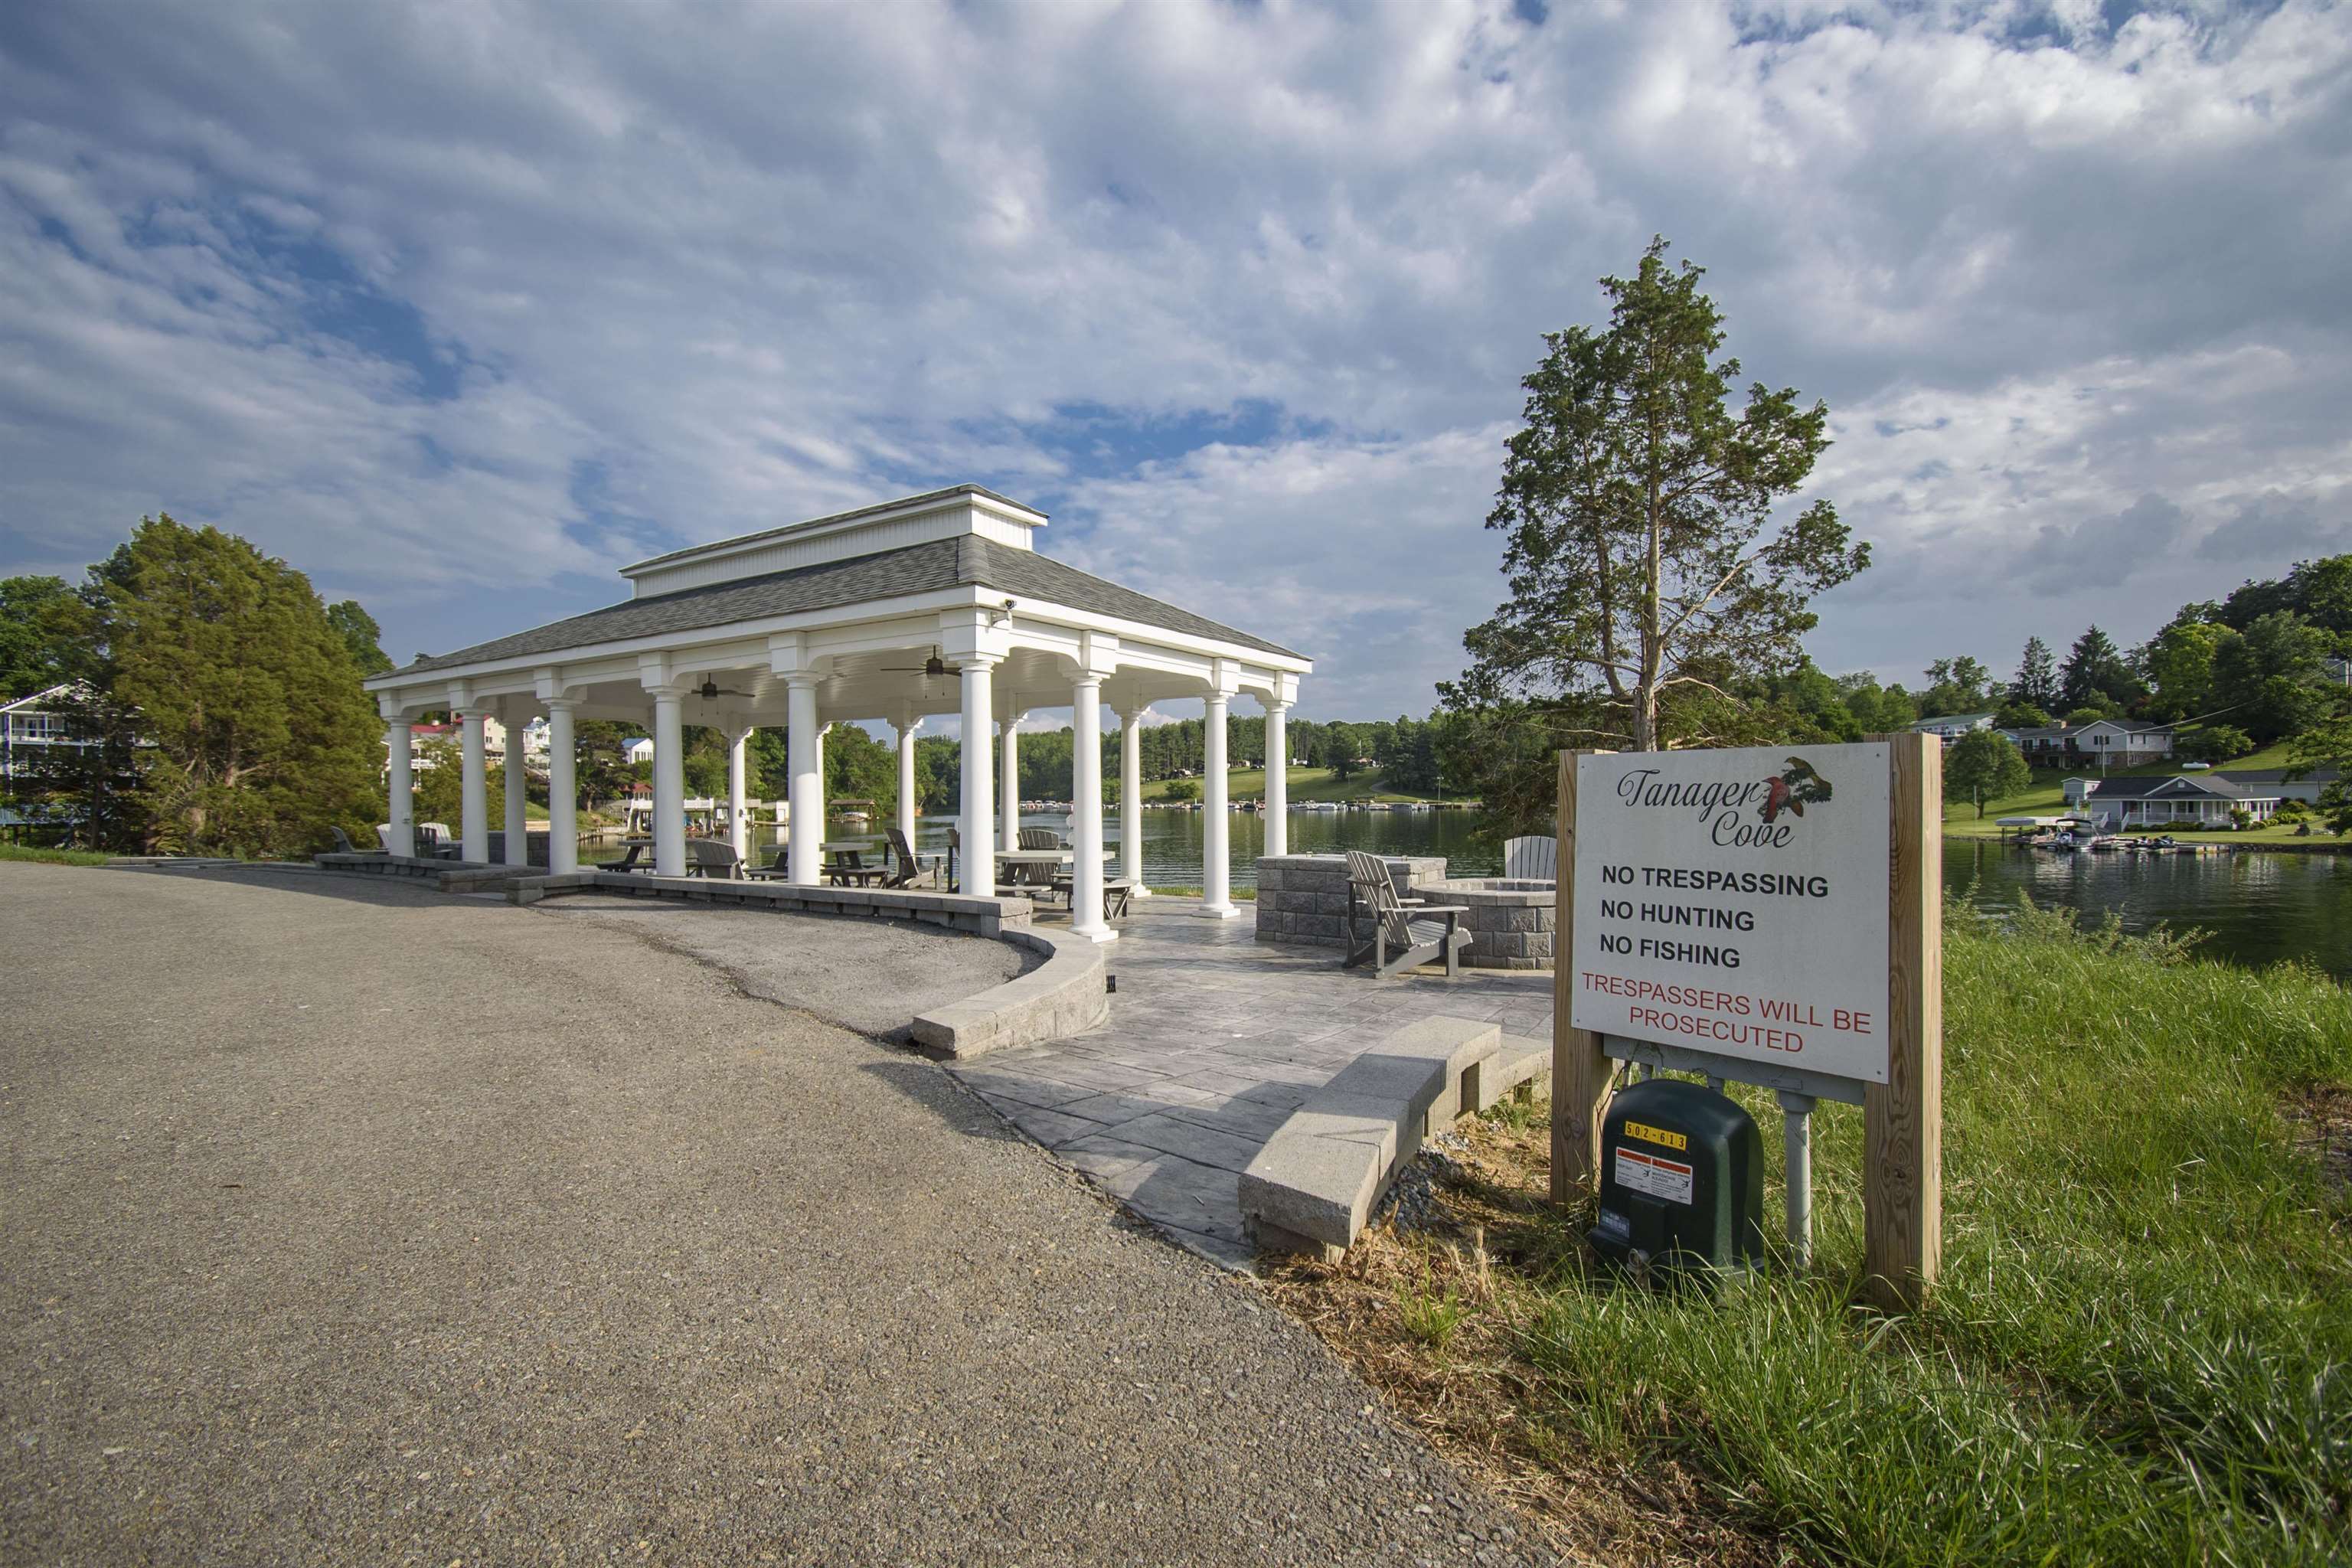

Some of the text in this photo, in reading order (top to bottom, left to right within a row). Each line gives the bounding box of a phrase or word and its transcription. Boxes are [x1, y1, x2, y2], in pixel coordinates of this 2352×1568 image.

[1617, 769, 1765, 822] Tanager
[1712, 812, 1795, 848] Cove
[1602, 866, 1828, 897] NO TRESPASSING
[1601, 900, 1754, 931] NO HUNTING
[1600, 934, 1740, 968] NO FISHING
[1583, 972, 1871, 1034] TRESPASSERS WILL BE
[1630, 1007, 1803, 1052] PROSECUTED
[1627, 1124, 1684, 1148] 502-613
